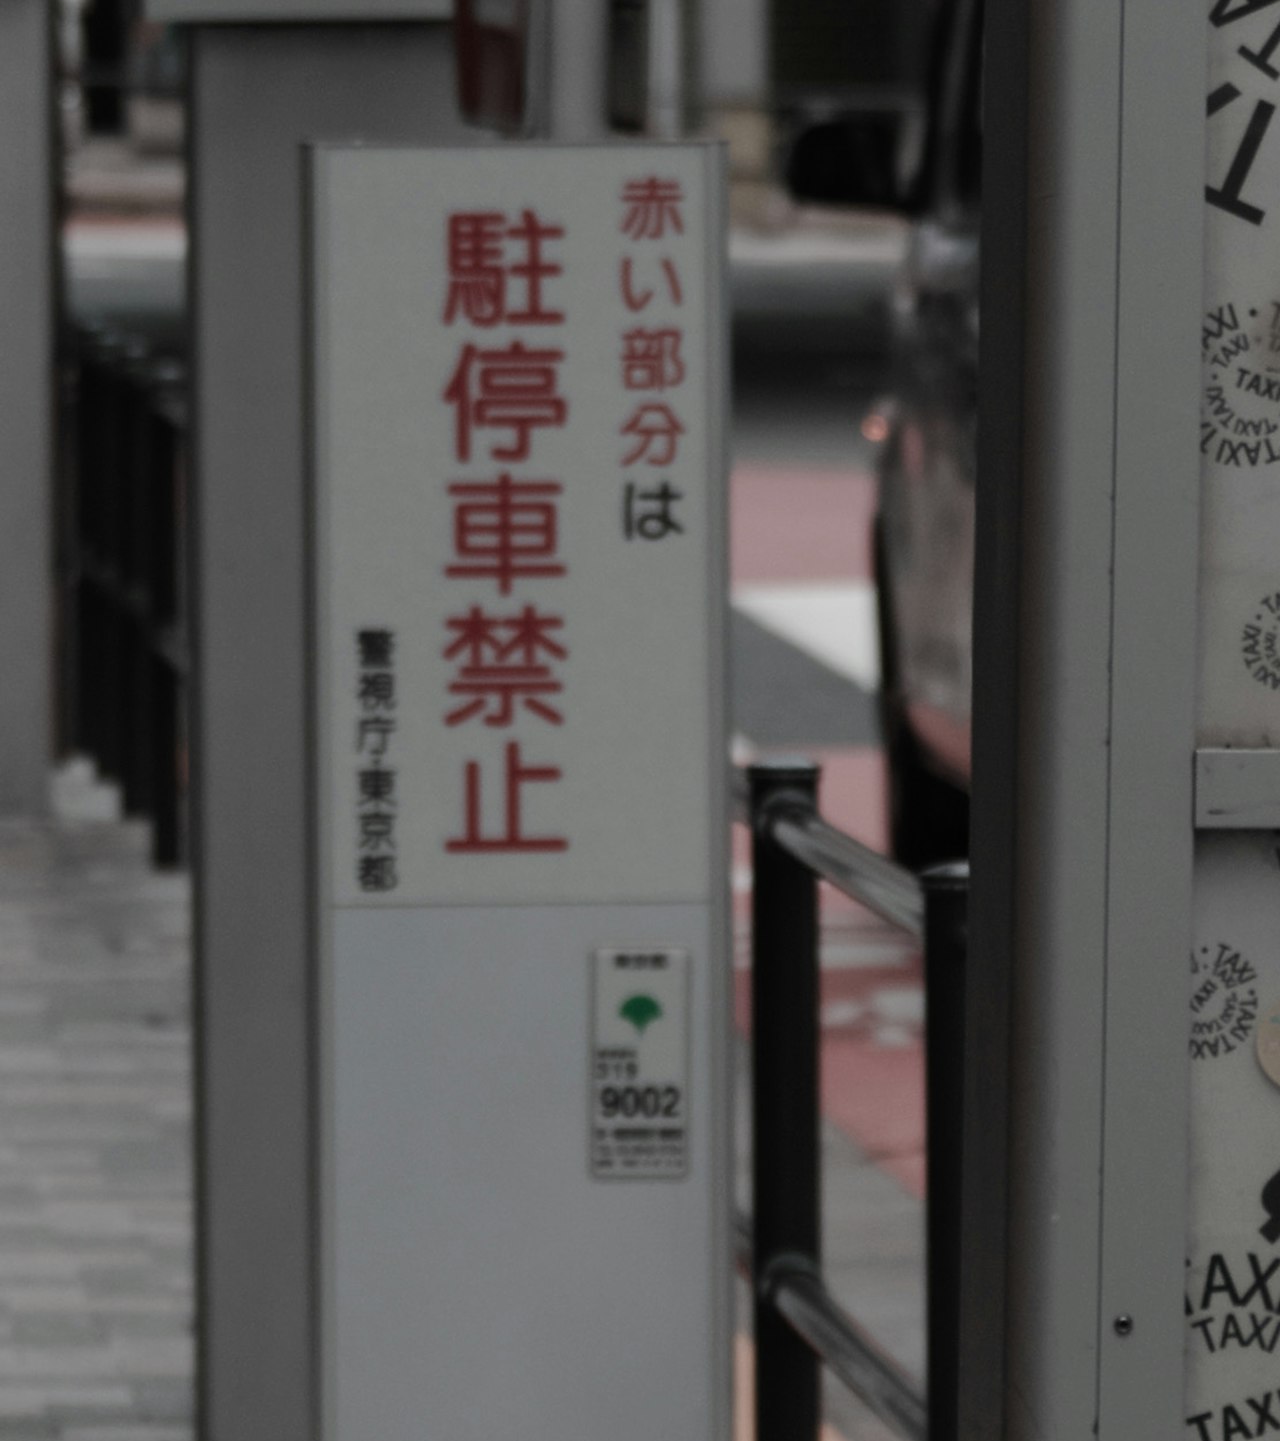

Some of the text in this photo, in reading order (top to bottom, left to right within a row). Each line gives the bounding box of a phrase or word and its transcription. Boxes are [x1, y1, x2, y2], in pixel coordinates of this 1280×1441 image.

[620, 177, 686, 541] 赤い部分は
[441, 211, 569, 856] 駐停車禁止
[1242, 623, 1262, 669] TAXI
[601, 1085, 681, 1119] 9002
